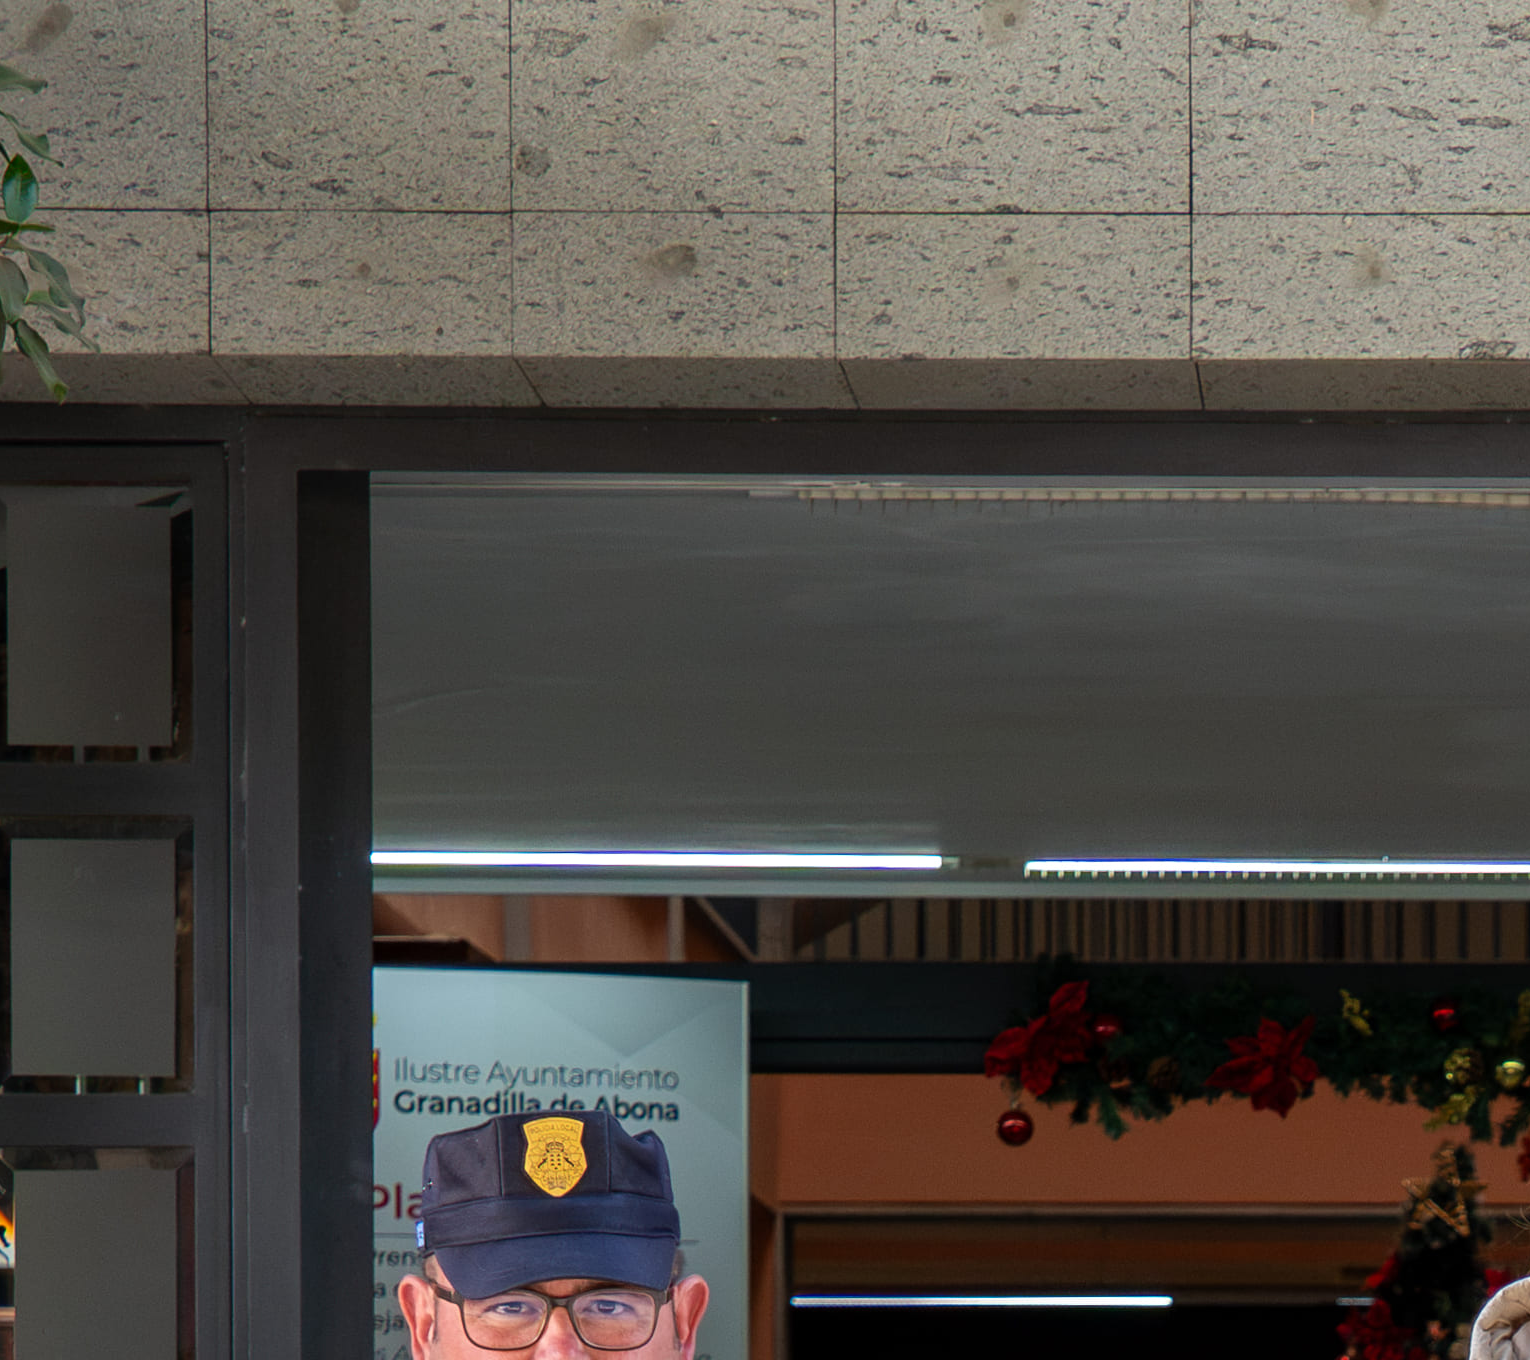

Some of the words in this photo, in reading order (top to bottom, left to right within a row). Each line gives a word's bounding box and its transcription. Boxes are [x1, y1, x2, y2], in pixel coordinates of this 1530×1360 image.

[394, 1057, 480, 1083] Ilustre
[486, 1060, 680, 1090] Ayuntamiento
[394, 1089, 541, 1115] Granadilla
[596, 1094, 679, 1120] Abona
